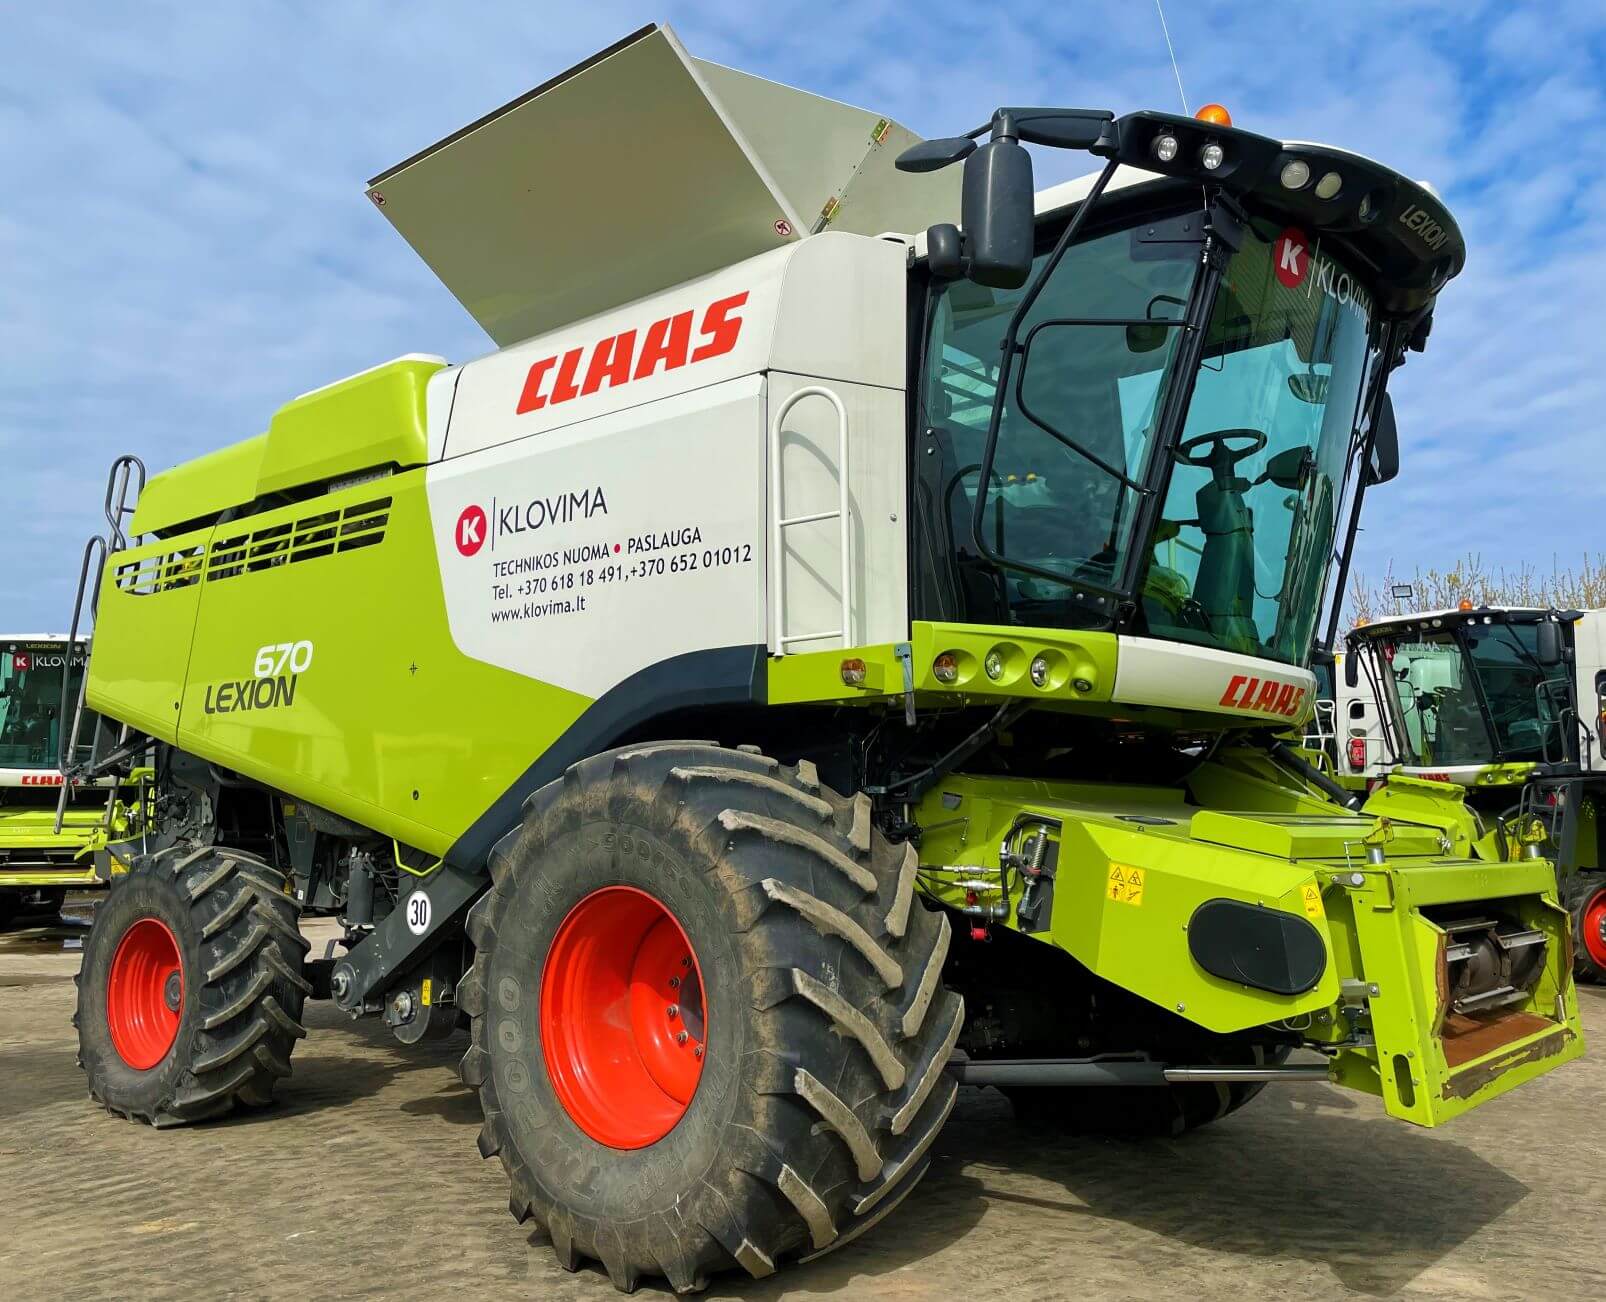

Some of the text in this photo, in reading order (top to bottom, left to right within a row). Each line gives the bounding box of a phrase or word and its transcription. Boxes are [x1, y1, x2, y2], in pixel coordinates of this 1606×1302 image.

[1400, 204, 1449, 251] LEXION
[1280, 238, 1304, 276] K
[516, 290, 750, 415] CLAAS
[461, 486, 608, 546] K KLOVIMA
[492, 585, 513, 600] Tel.
[517, 577, 547, 596] +370
[551, 572, 575, 591] 618
[579, 569, 594, 587] 18
[670, 553, 698, 574] 652
[702, 544, 752, 569] 01012
[493, 527, 702, 578] TECHNIKOS NUOMA PASLAUGA
[491, 595, 587, 623] www.klovima.lt
[254, 640, 314, 678] 670
[204, 674, 298, 715] LEXION
[1218, 675, 1306, 716] CLAAS
[410, 899, 427, 926] 30
